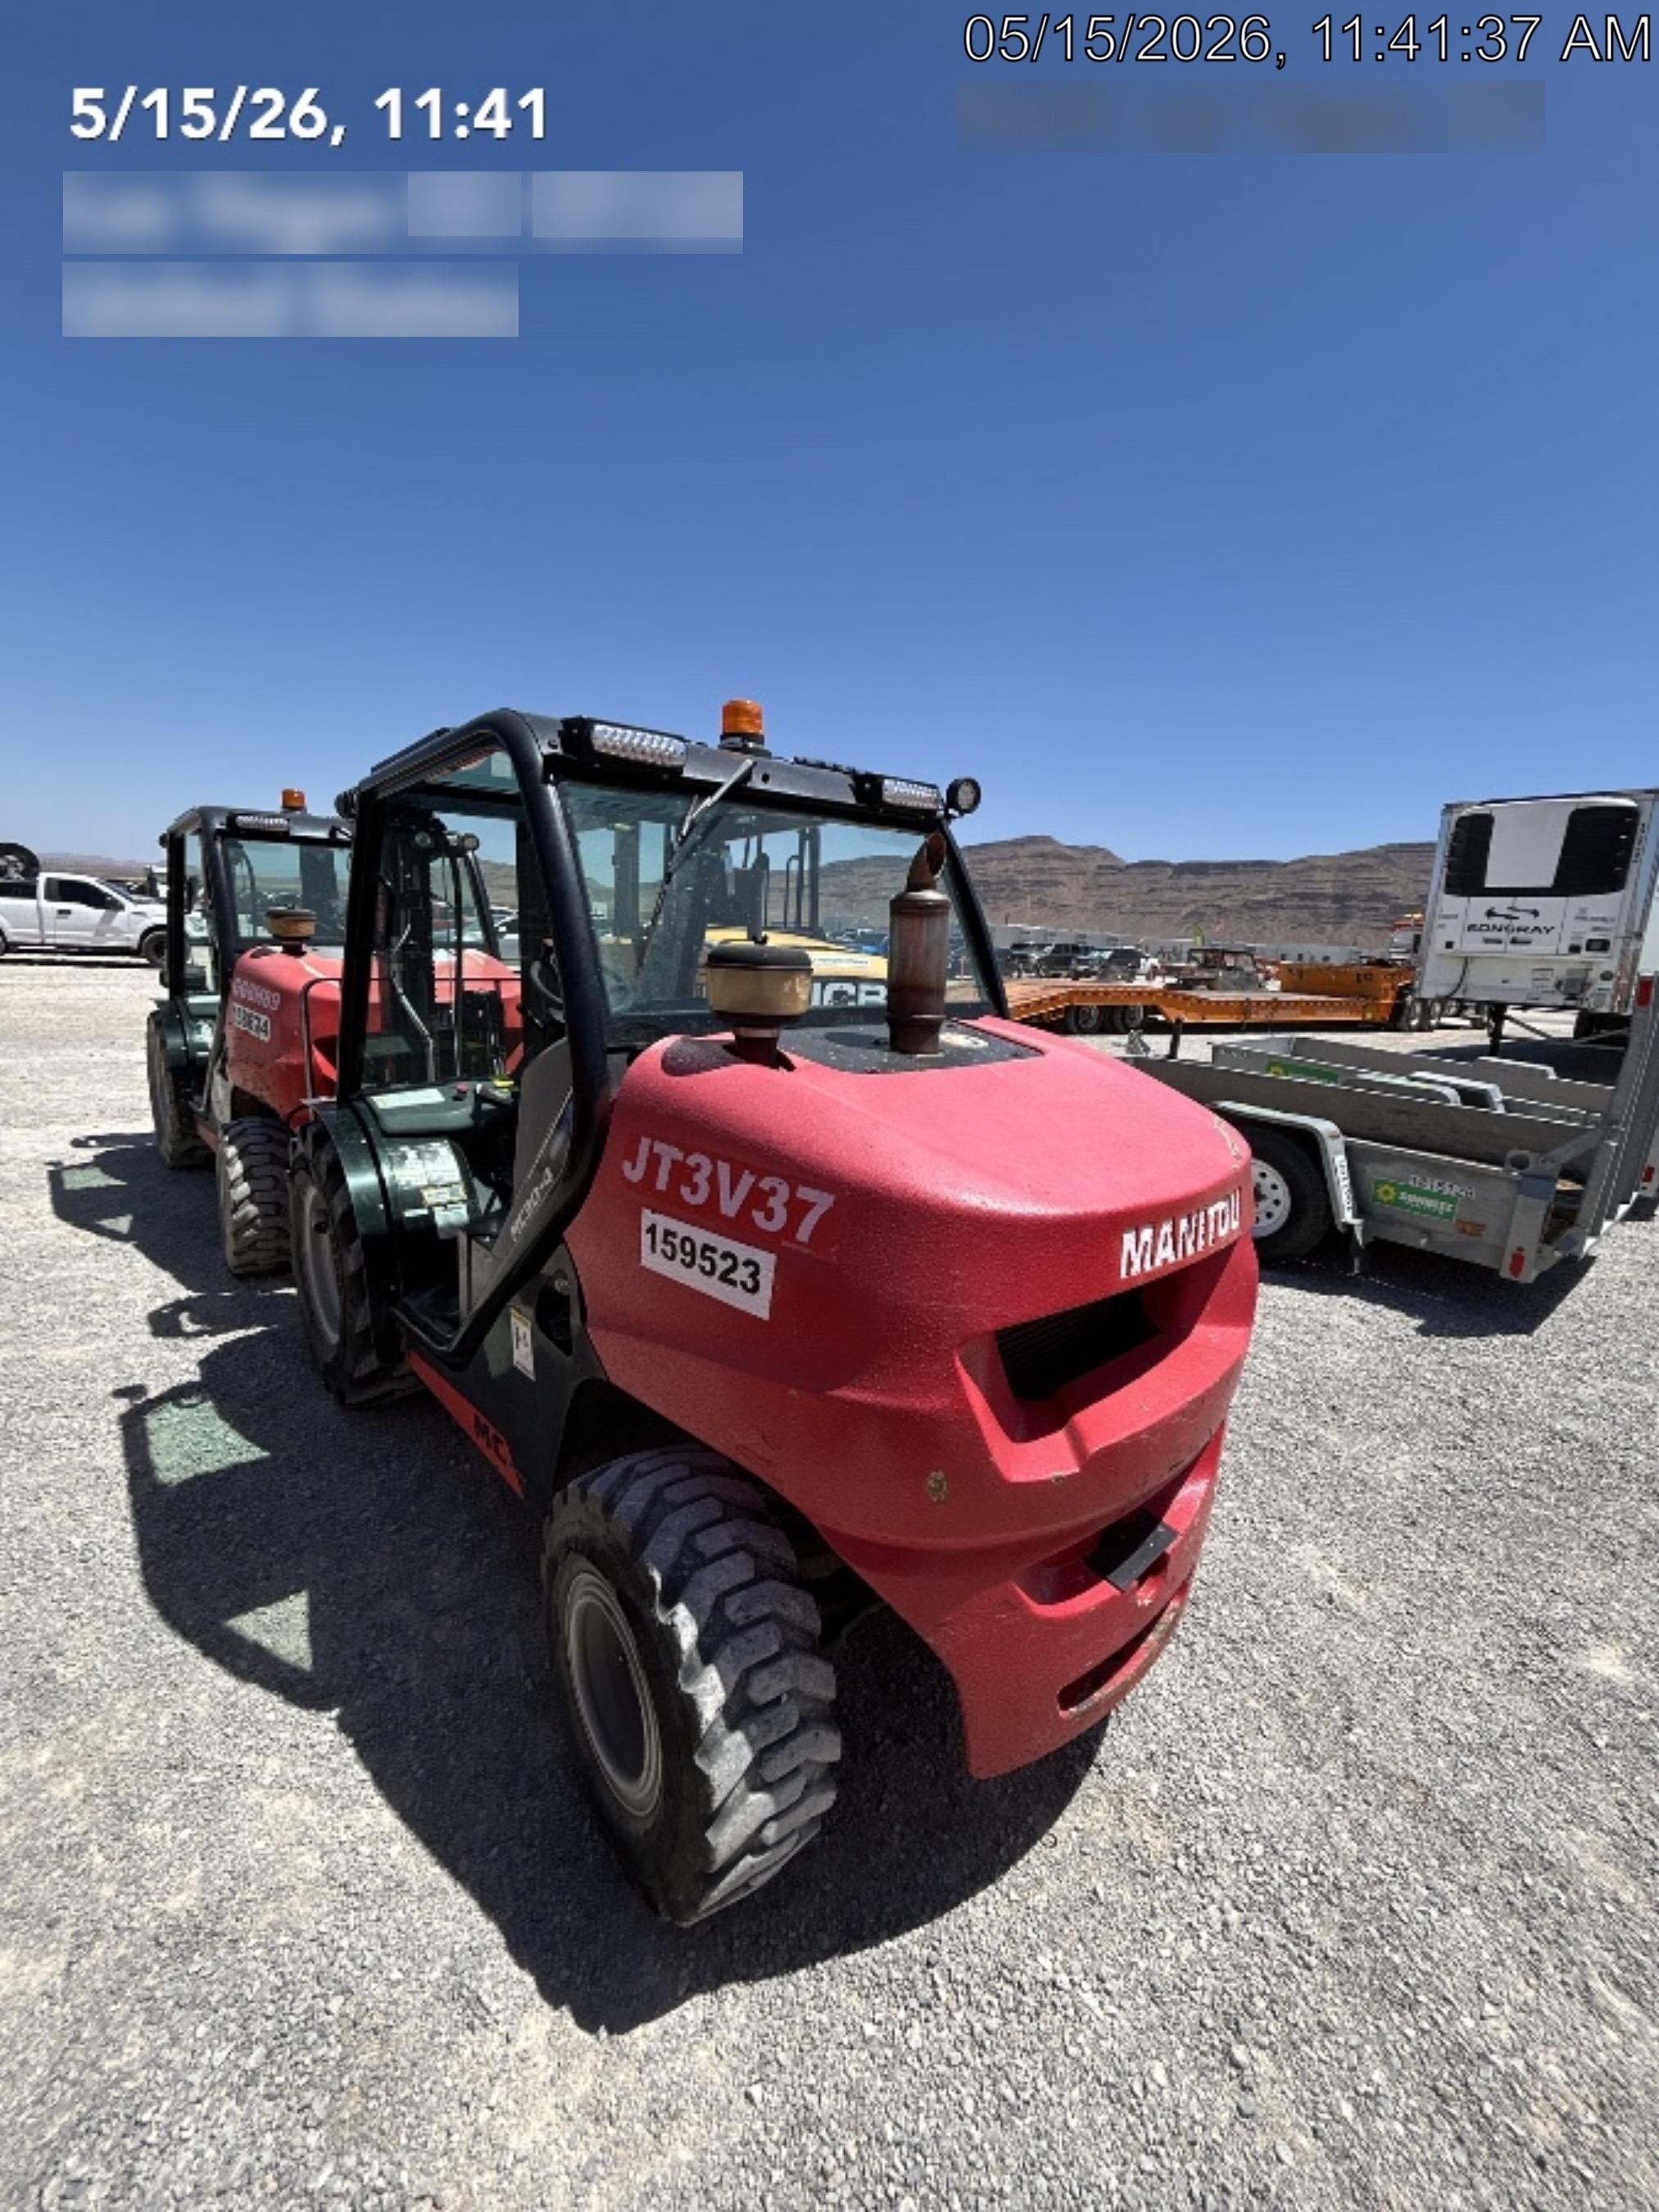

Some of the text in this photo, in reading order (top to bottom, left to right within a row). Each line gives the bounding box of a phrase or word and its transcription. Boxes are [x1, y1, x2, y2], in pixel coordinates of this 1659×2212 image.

[622, 1136, 836, 1244] JT3V37
[1119, 1188, 1242, 1280] MANITOU
[645, 1223, 762, 1295] 159523
